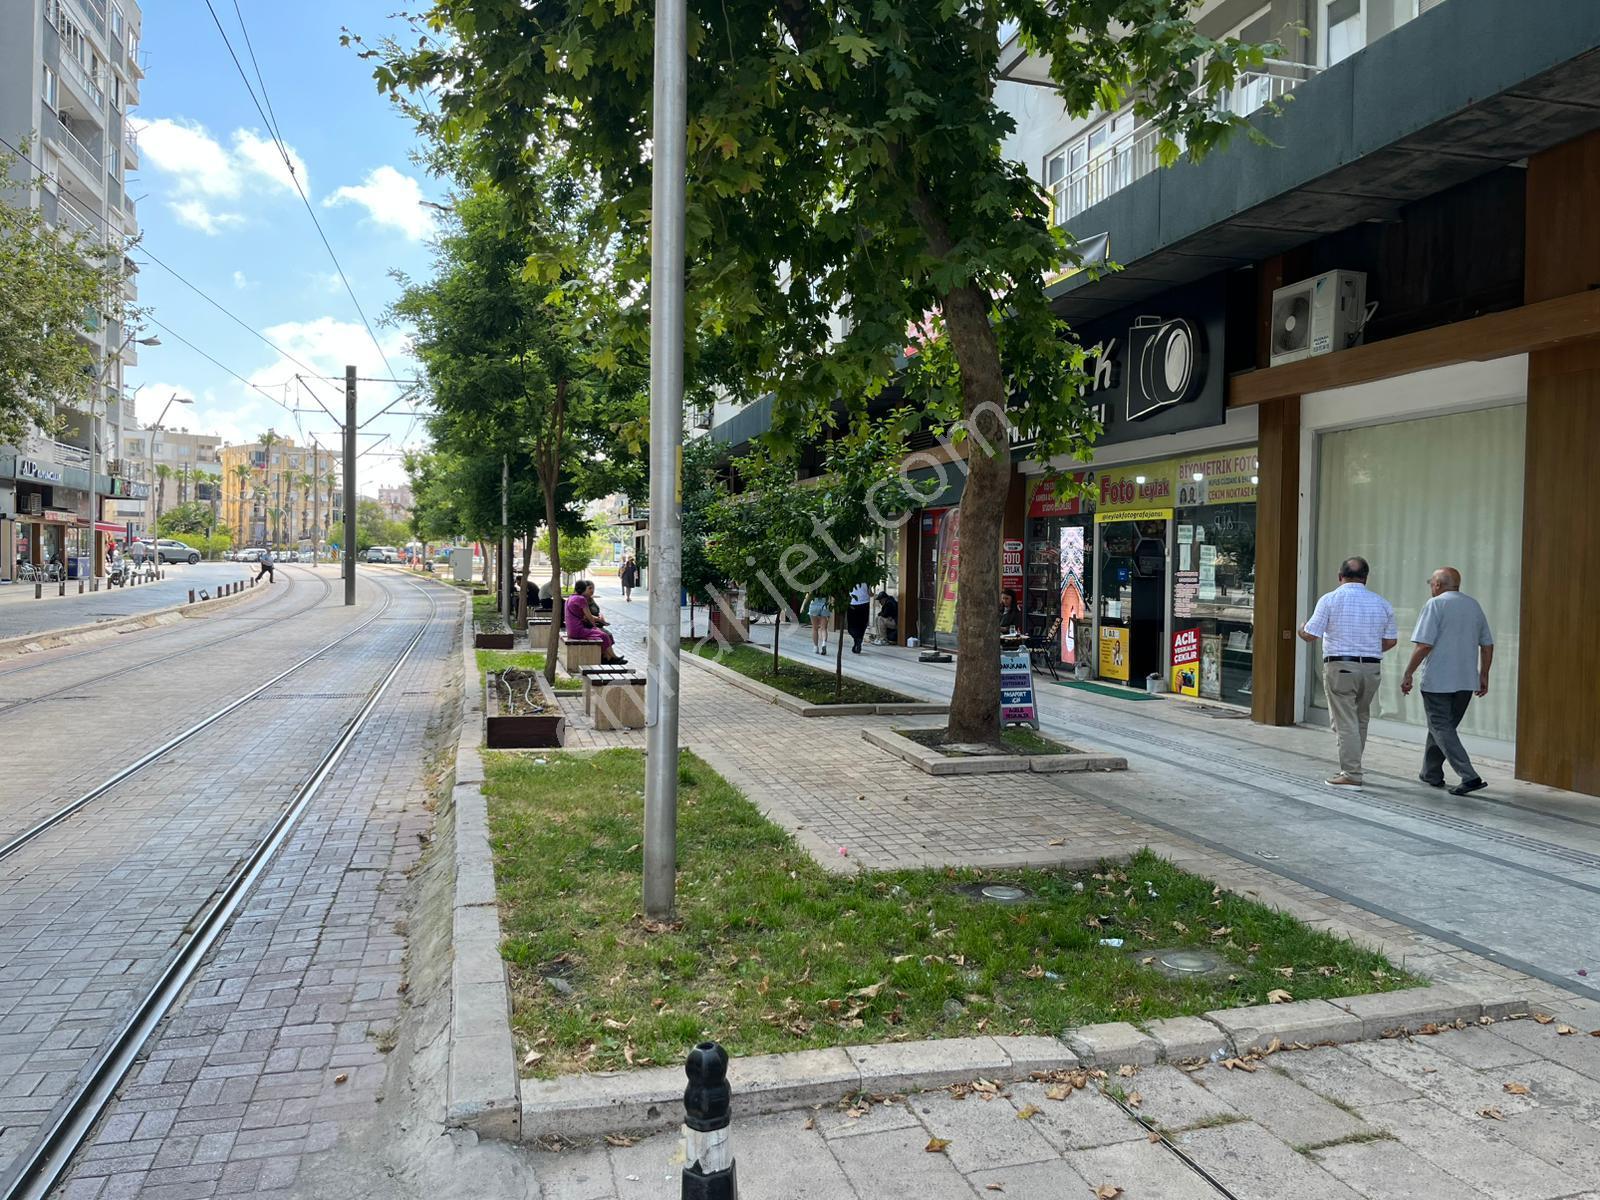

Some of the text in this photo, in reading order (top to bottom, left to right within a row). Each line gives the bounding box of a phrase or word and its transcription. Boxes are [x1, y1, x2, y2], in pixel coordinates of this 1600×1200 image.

[1179, 456, 1232, 479] BİYOMETRİK
[1100, 475, 1170, 505] Foto Leylak
[1003, 552, 1021, 564] FOTO
